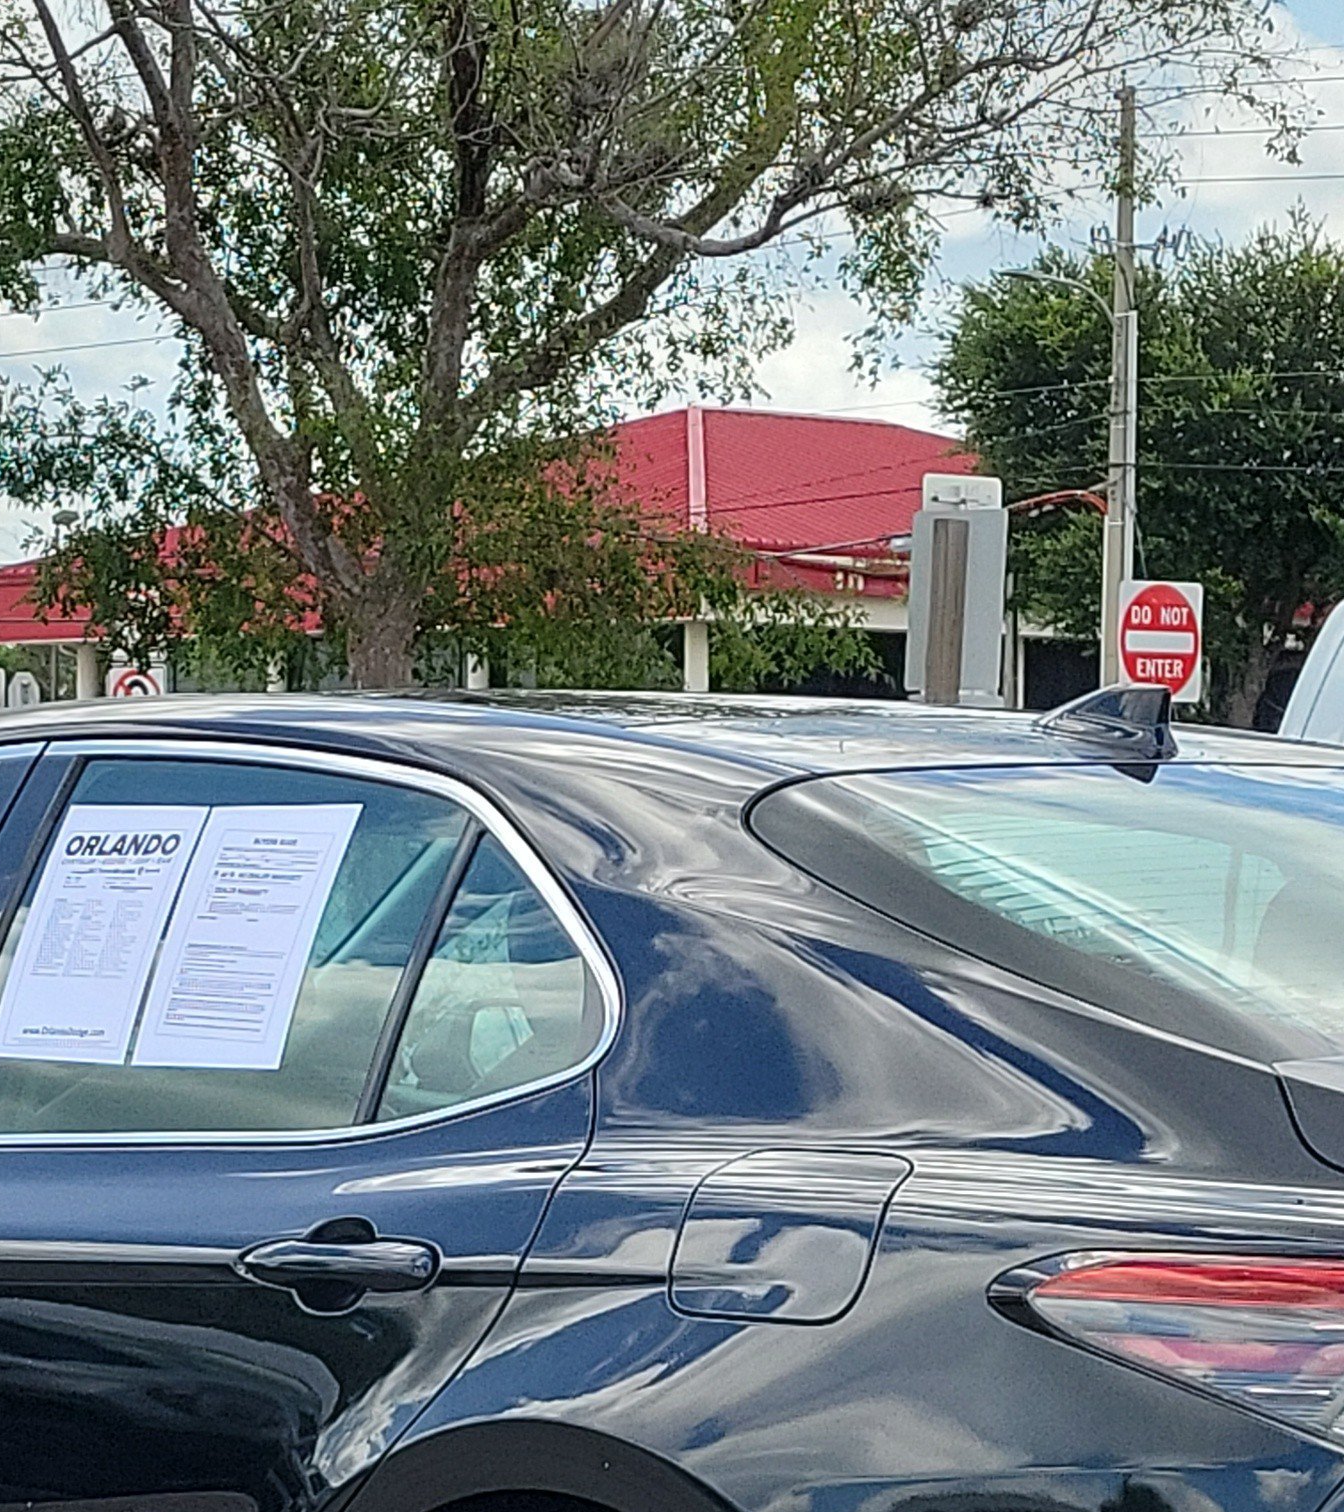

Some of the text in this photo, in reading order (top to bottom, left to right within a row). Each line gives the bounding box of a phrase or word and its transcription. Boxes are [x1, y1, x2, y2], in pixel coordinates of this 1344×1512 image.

[1131, 605, 1189, 626] DO NOT
[1136, 657, 1184, 679] ENTER
[65, 833, 182, 856] ORLANDO
